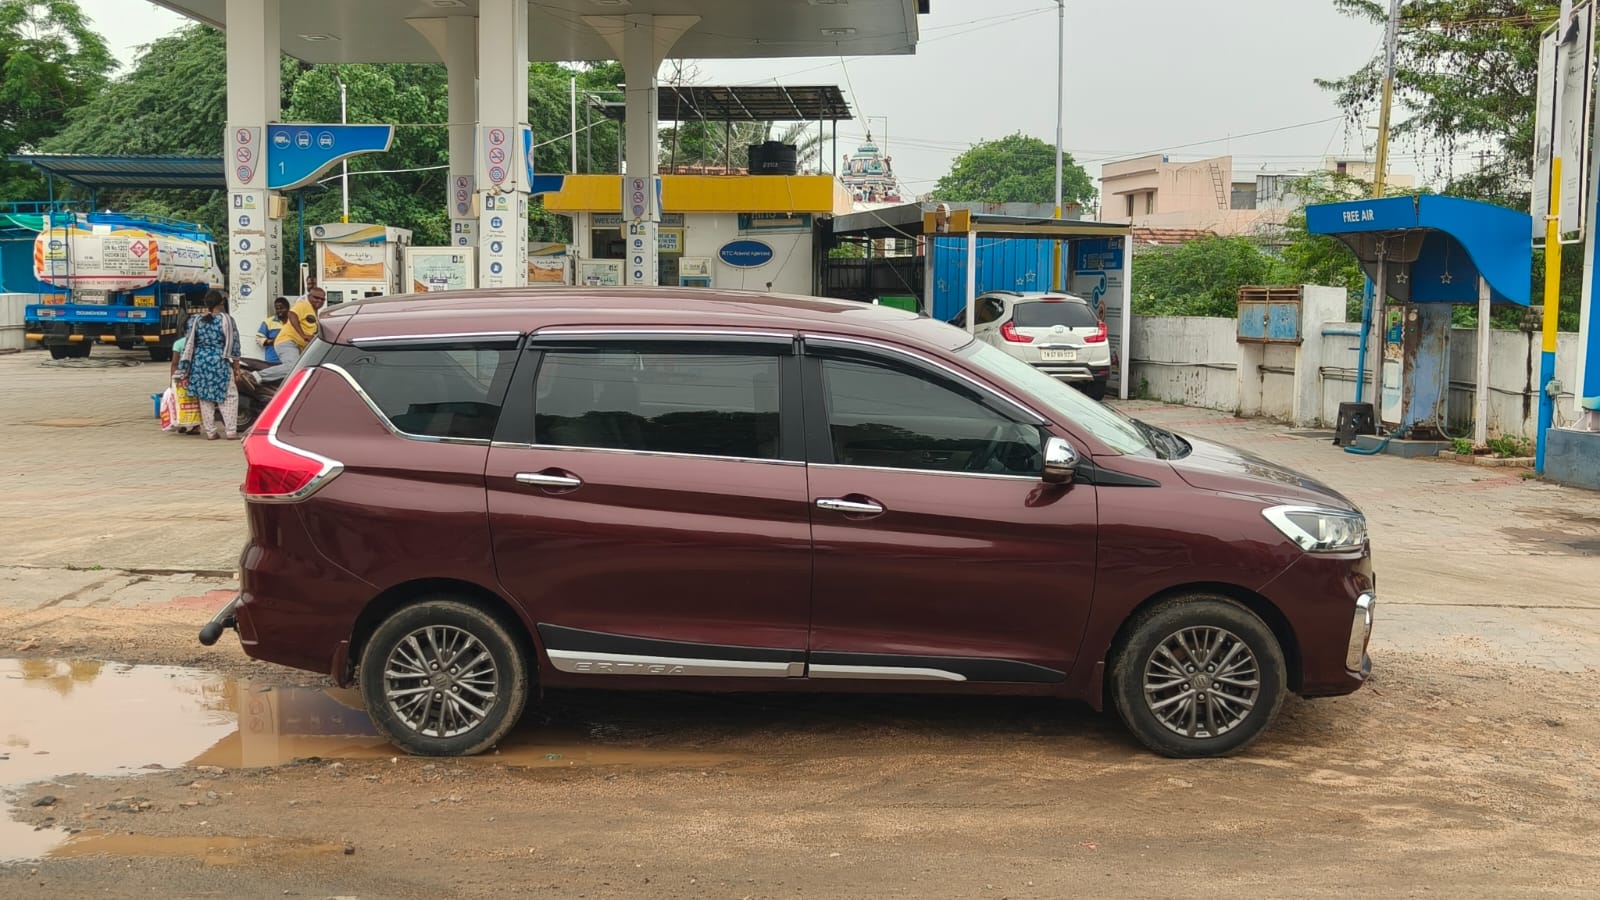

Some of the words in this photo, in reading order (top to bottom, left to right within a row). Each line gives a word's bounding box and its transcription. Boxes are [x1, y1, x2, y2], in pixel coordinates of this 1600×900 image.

[277, 160, 285, 176] 1
[1342, 210, 1361, 223] FREE
[1361, 208, 1375, 221] AIR
[574, 661, 686, 674] ERTIGA
